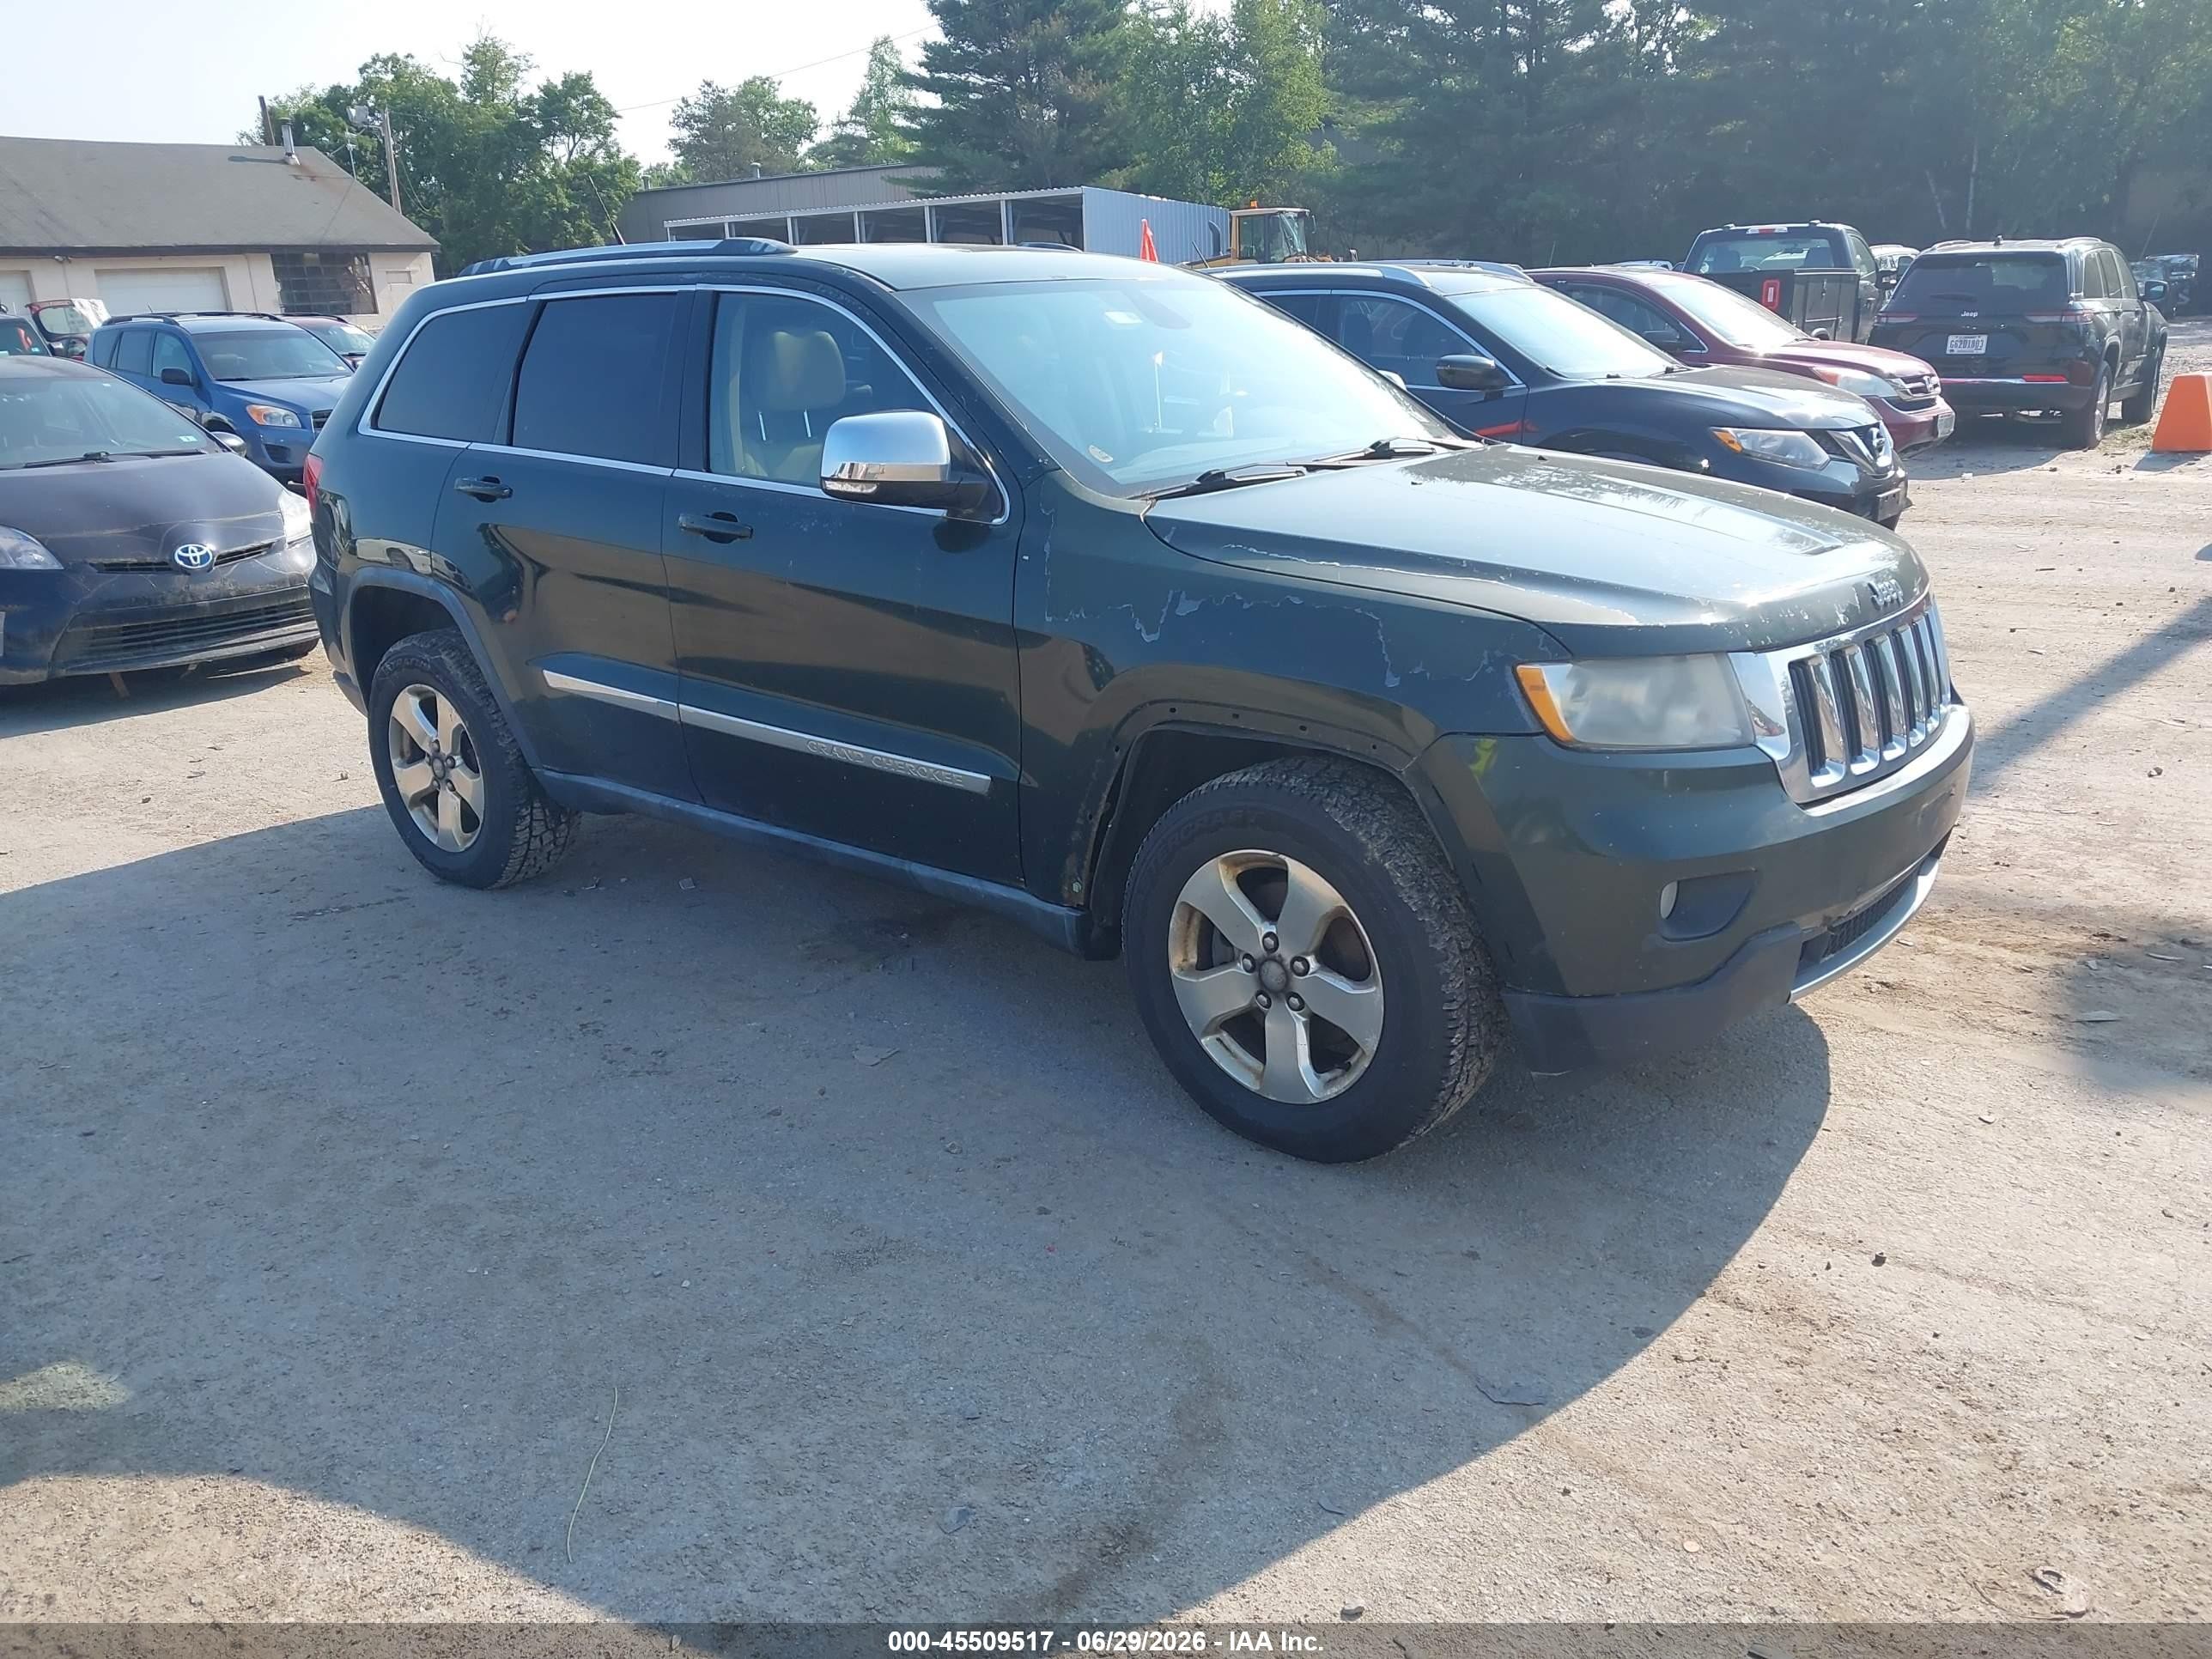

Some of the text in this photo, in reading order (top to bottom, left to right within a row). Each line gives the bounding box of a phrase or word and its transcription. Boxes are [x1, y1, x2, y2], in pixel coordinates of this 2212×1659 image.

[1868, 579, 1904, 606] Jeep
[805, 740, 965, 787] GRAND CHEROKEE
